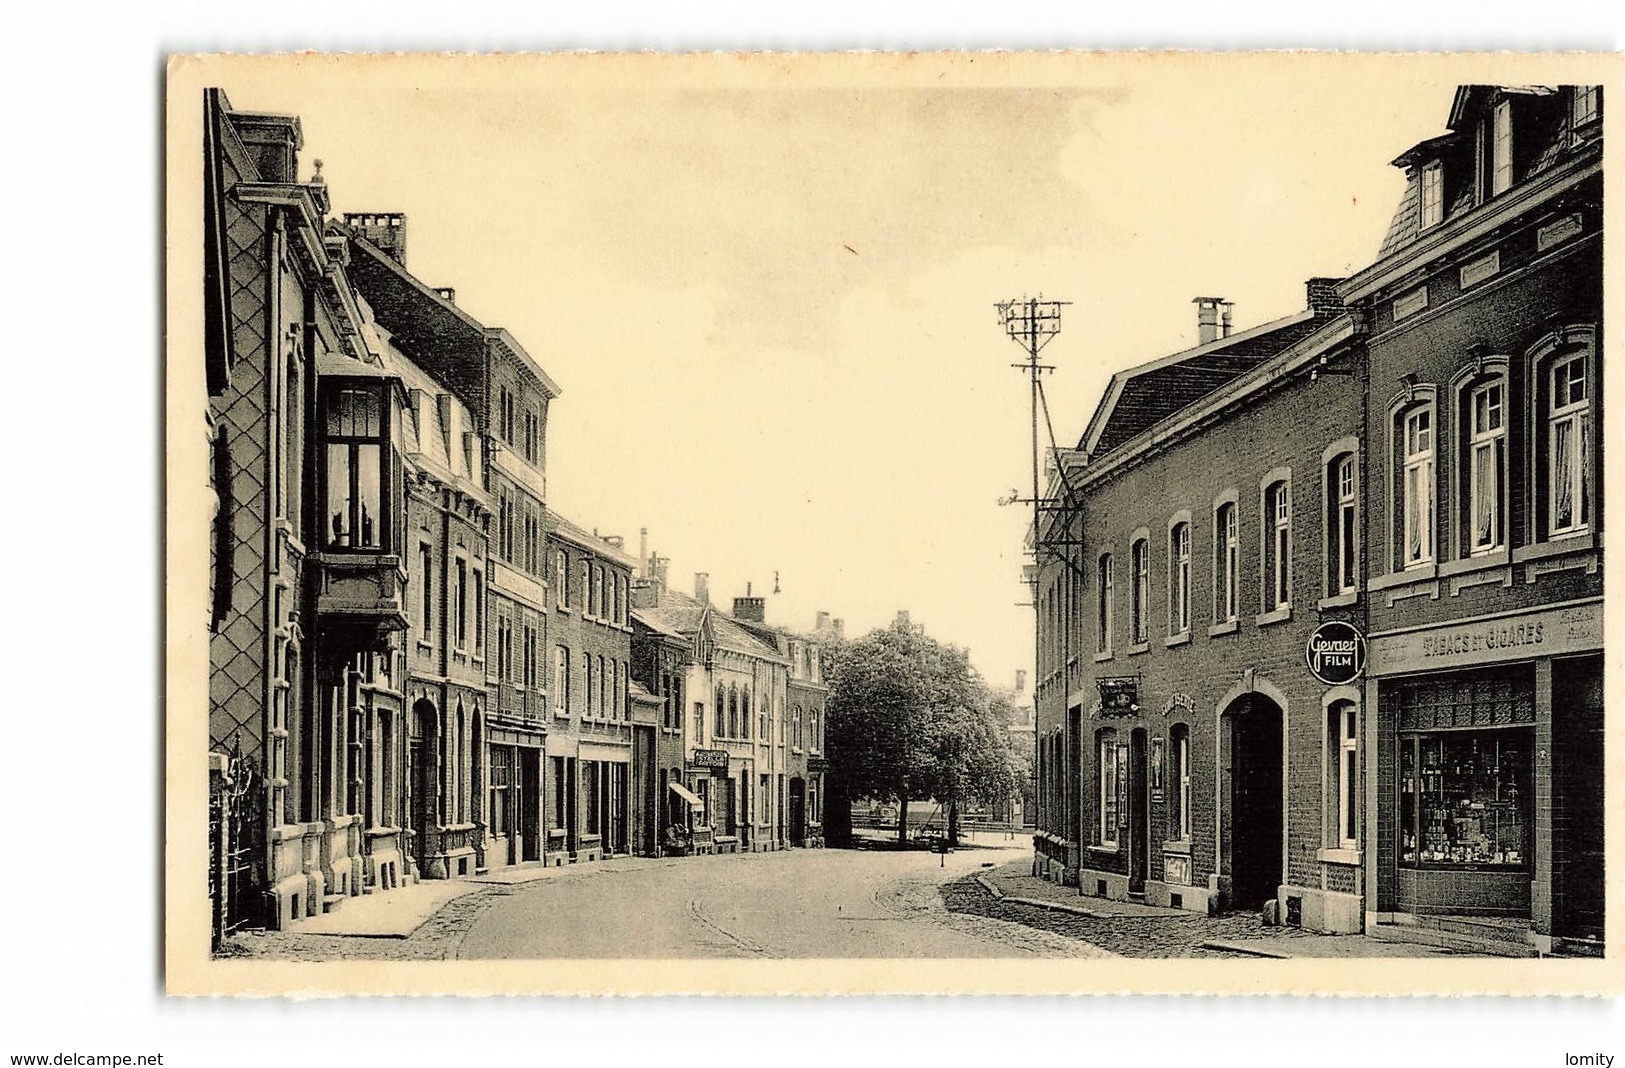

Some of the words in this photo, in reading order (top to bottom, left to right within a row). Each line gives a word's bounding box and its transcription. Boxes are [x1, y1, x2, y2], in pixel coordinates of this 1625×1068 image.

[1311, 633, 1360, 672] Gevaert
[1423, 634, 1469, 657] TABACS
[1486, 623, 1544, 650] CIGARES
[1325, 656, 1351, 666] FILM
